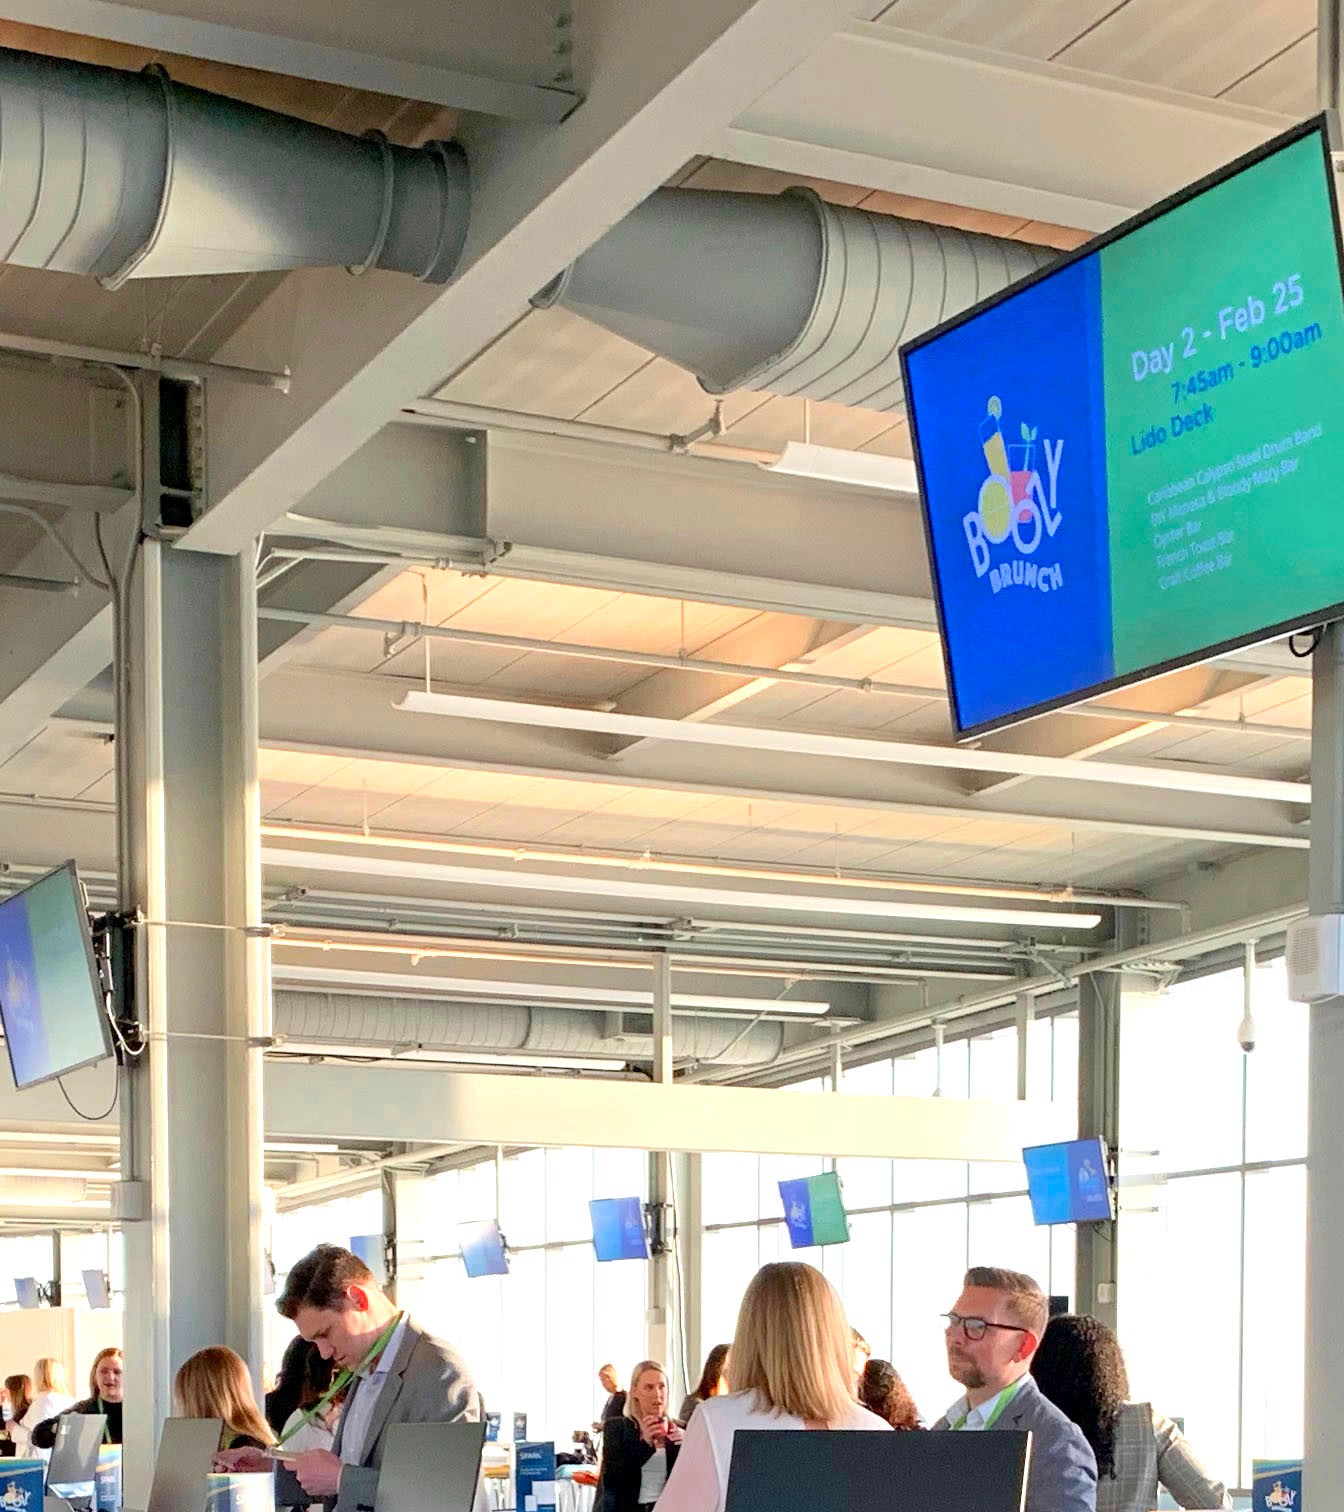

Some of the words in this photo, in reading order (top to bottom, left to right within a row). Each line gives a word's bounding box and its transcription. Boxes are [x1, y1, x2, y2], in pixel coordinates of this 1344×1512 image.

[1132, 343, 1174, 381] Day
[1181, 327, 1197, 358] 2
[1218, 296, 1264, 340] Feb
[1272, 273, 1304, 316] 25
[1171, 363, 1234, 404] 7:45am
[1250, 323, 1323, 368] 9:00am
[1131, 424, 1167, 456] Lido
[1170, 402, 1214, 437] Deck
[1262, 437, 1293, 459] Drum
[963, 439, 1064, 578] BOOZY
[989, 560, 1064, 594] BRUNCH
